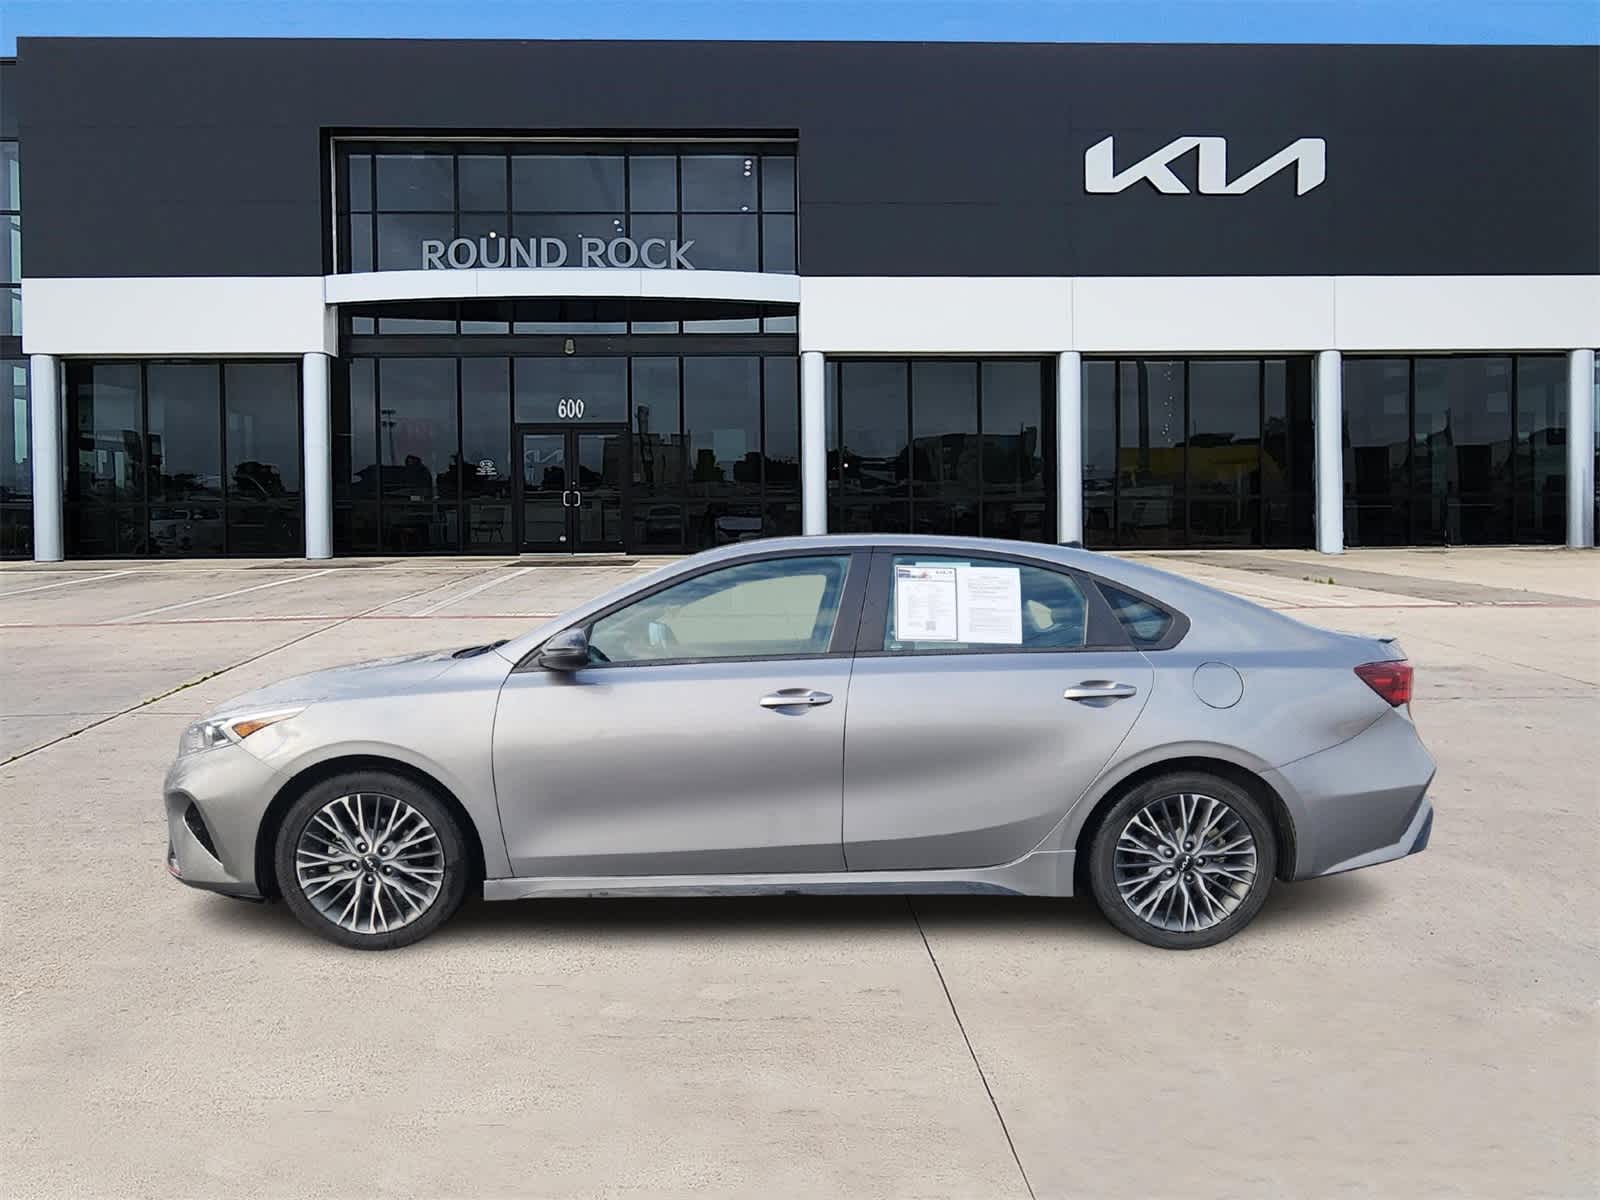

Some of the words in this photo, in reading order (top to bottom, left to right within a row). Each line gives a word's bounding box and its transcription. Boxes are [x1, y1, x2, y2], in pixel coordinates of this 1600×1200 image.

[1085, 135, 1326, 196] KIA
[421, 237, 568, 270] ROUND
[581, 237, 696, 270] ROCK
[557, 399, 585, 418] 600
